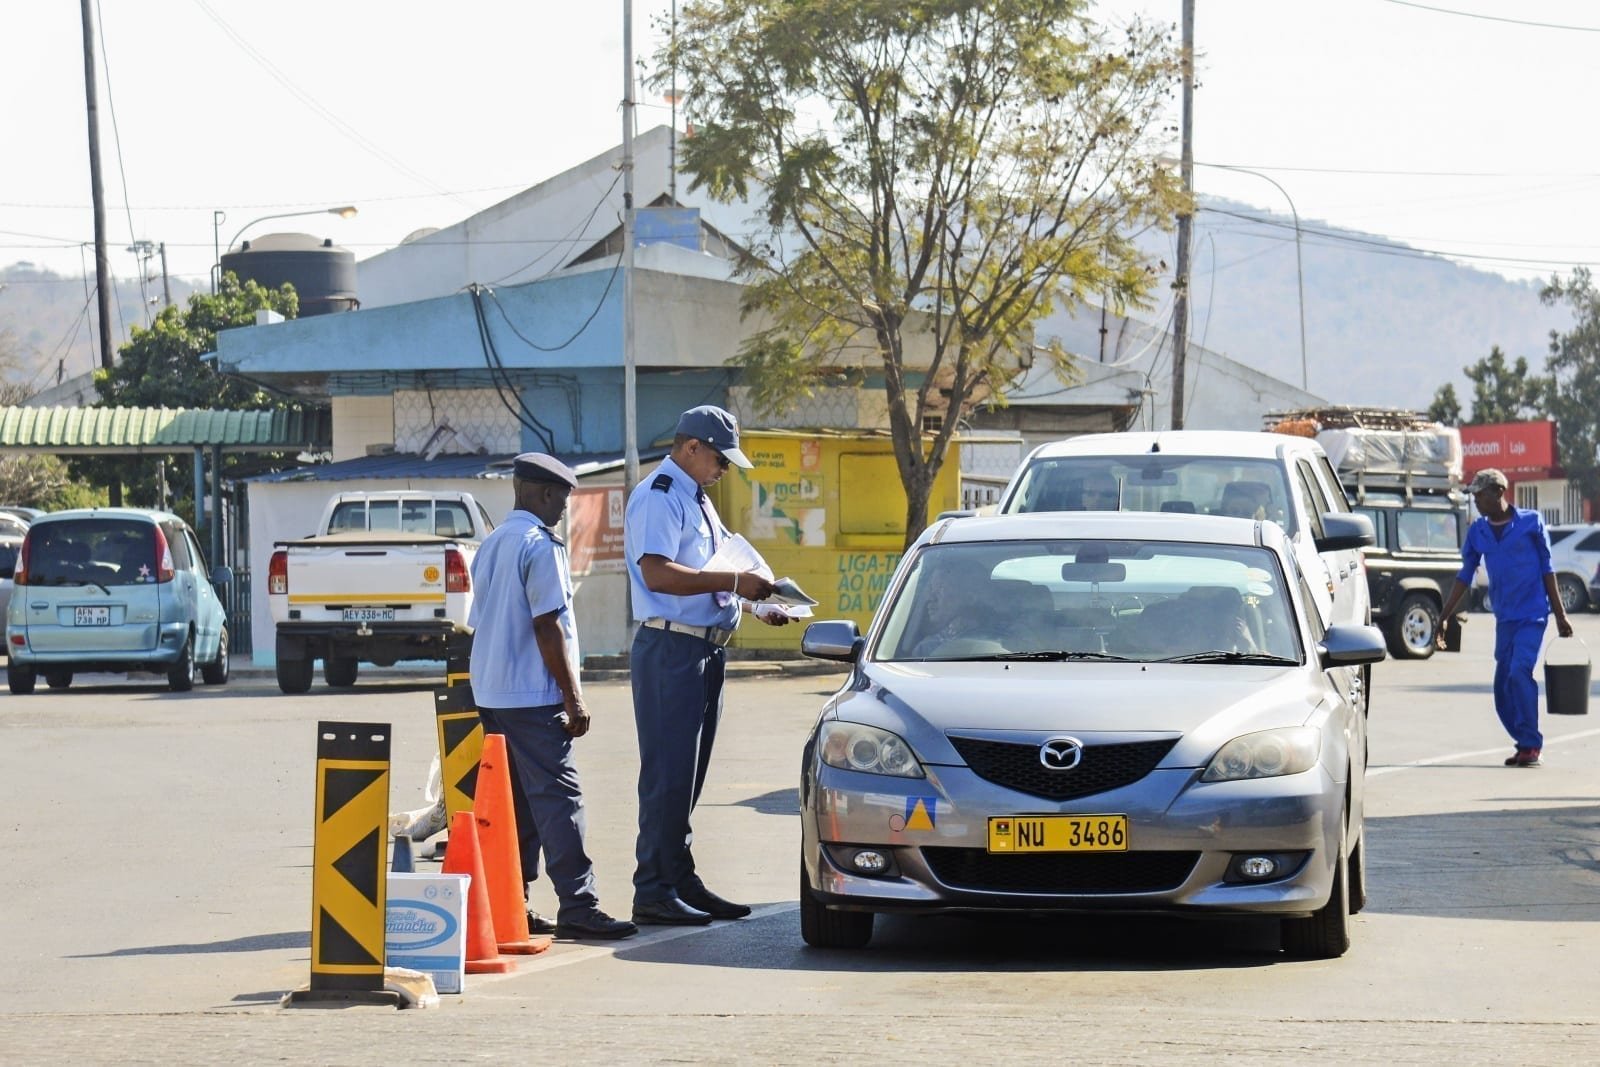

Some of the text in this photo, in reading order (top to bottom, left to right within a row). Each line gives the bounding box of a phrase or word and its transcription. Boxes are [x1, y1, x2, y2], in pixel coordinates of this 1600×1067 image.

[752, 451, 770, 460] Leva
[1462, 439, 1500, 456] odacom
[838, 574, 864, 592] AO
[838, 593, 862, 612] DA
[1018, 821, 1124, 847] NU 3486
[386, 918, 437, 932] maacha
